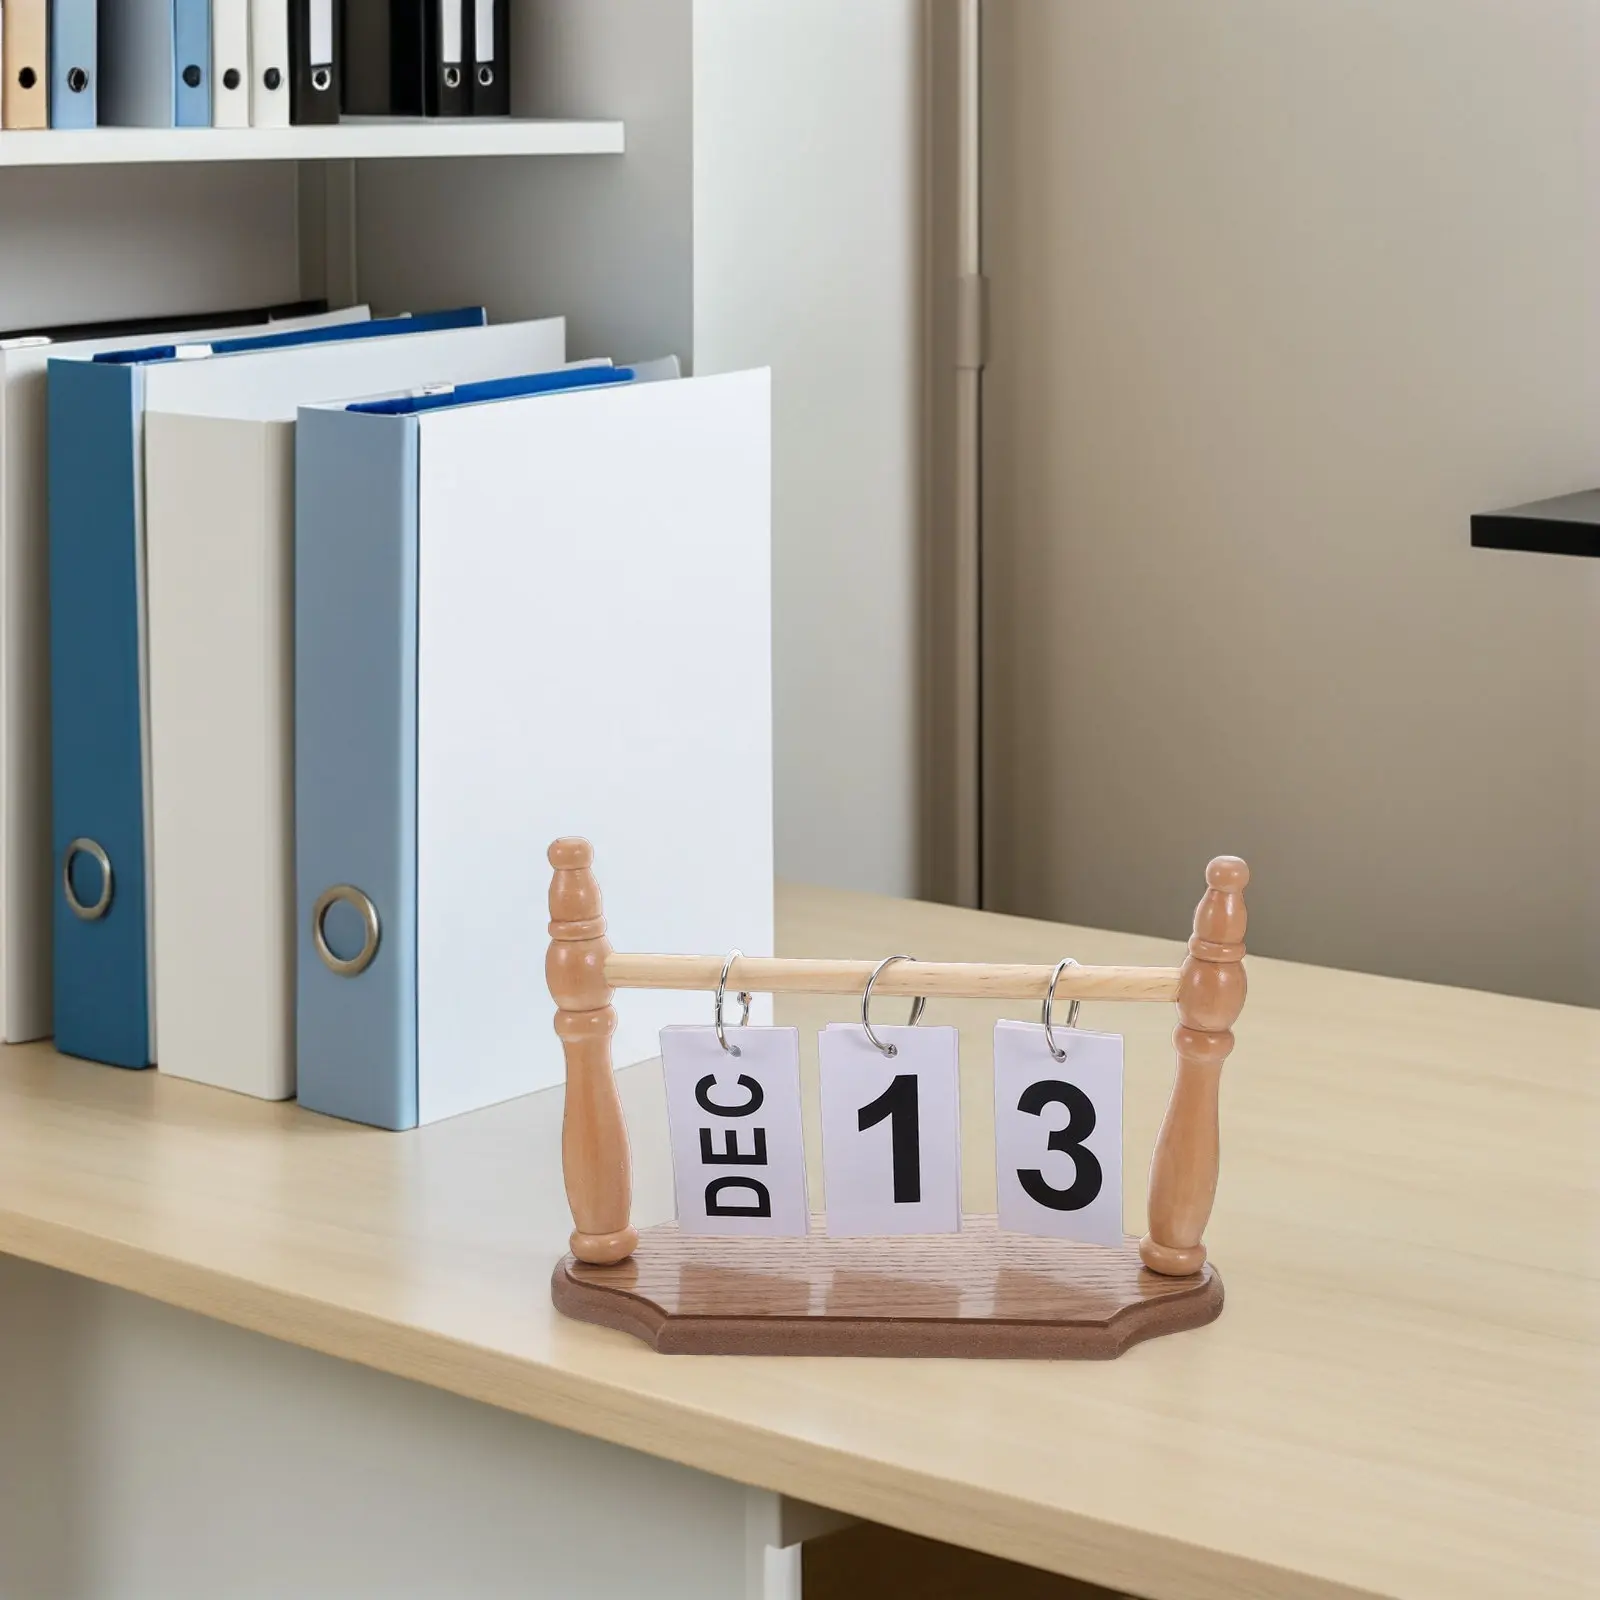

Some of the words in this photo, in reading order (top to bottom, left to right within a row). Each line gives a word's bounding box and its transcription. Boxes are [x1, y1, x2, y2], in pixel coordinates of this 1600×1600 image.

[695, 1073, 772, 1218] DEC
[857, 1074, 921, 1204] 1
[1016, 1079, 1103, 1212] 3
